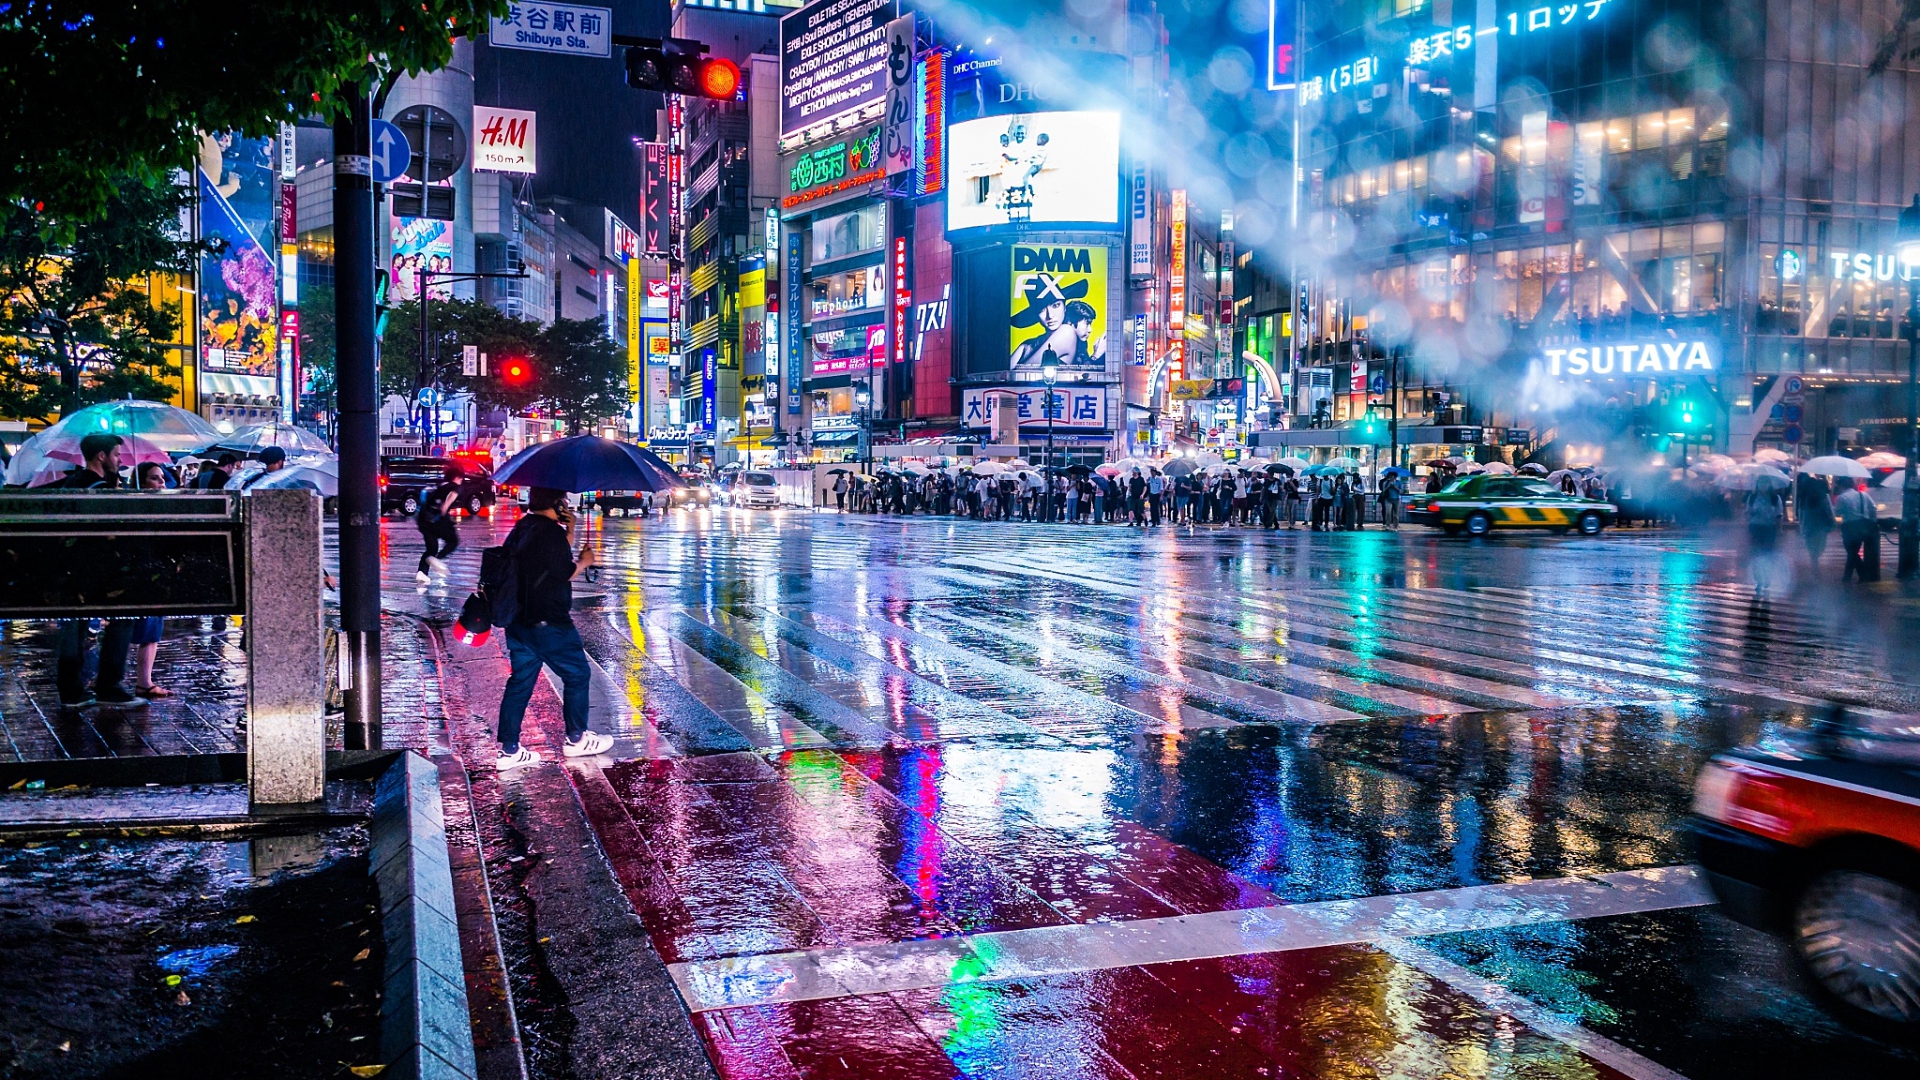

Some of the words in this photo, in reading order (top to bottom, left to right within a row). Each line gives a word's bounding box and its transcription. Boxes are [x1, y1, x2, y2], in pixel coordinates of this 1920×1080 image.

[500, 5, 602, 36] 渋谷駅前
[515, 30, 562, 48] Shibuya
[566, 35, 590, 49] Sta.
[953, 62, 970, 75] DHC
[970, 56, 1003, 70] Channel
[480, 115, 528, 149] H&M
[485, 154, 514, 164] 150m
[1013, 247, 1092, 273] DMM
[1013, 274, 1065, 300] FX
[815, 297, 864, 315] Euphoria
[653, 337, 669, 353] 薬
[1546, 342, 1713, 376] TSUTAYA
[1859, 417, 1908, 425] STARBUCKS
